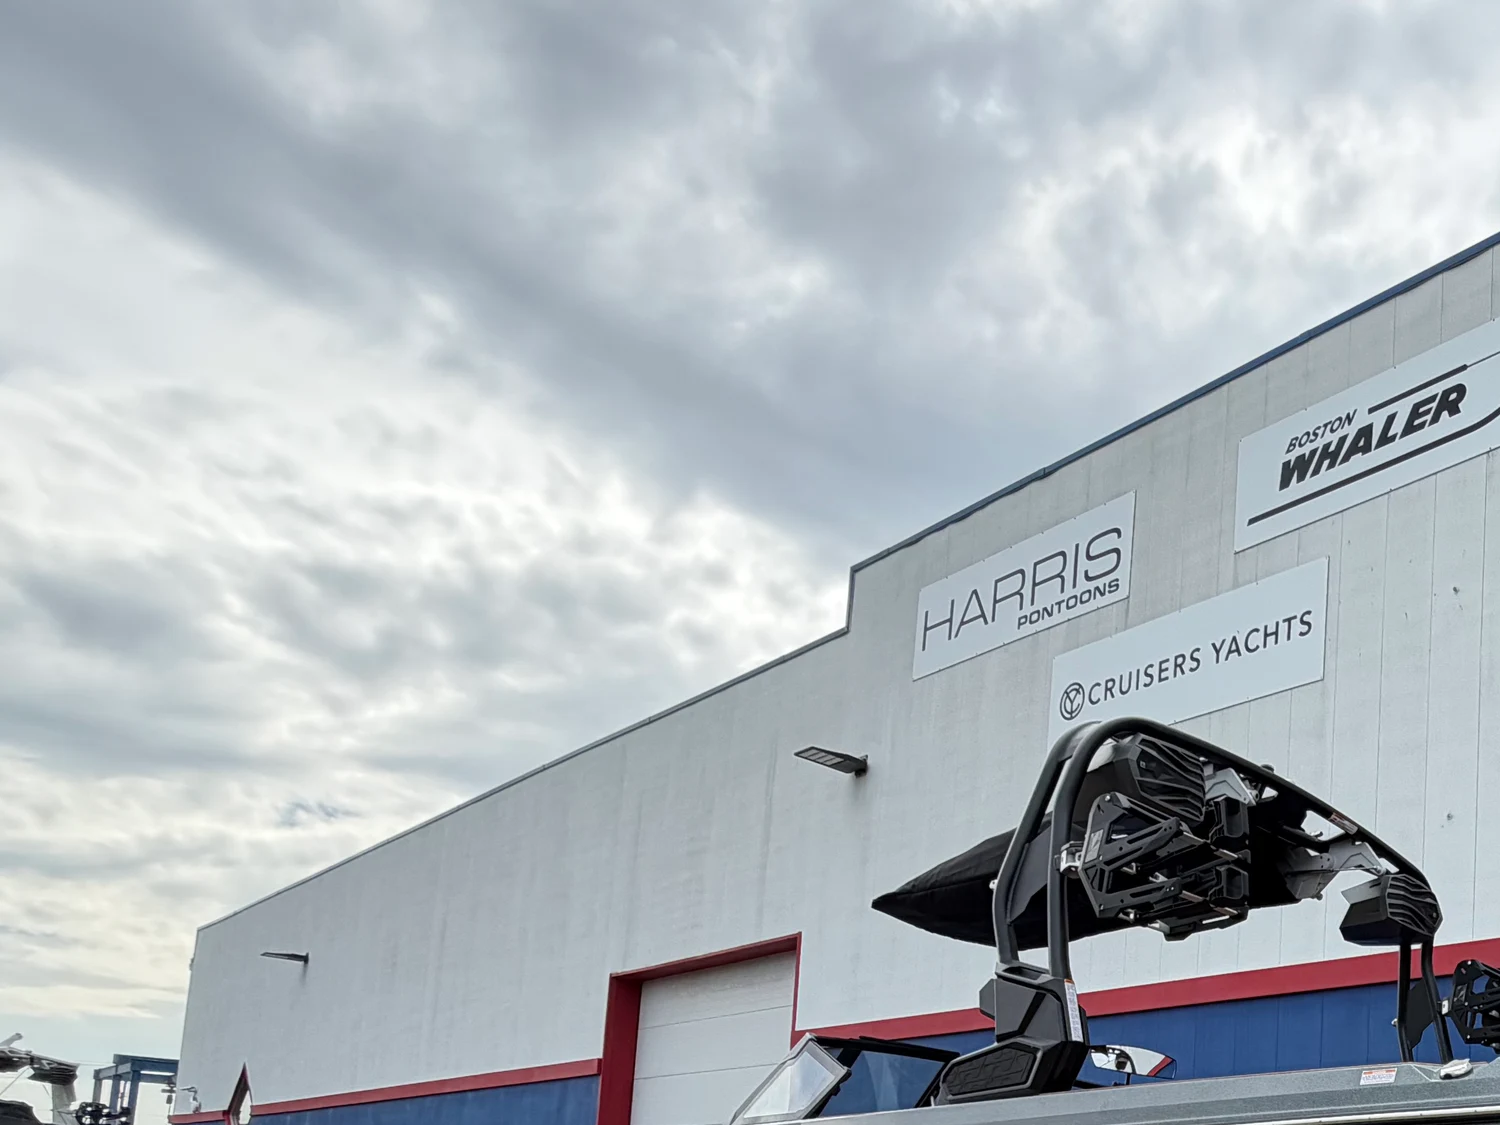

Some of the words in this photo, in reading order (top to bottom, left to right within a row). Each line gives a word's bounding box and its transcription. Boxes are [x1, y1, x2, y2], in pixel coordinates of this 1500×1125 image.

[1278, 382, 1467, 492] WHALER
[1284, 408, 1358, 455] BOSTON
[921, 527, 1122, 652] HARRIS
[1017, 578, 1121, 631] PONTOONS
[1087, 647, 1202, 706] CRUISERS
[1210, 609, 1313, 665] YACHTS
